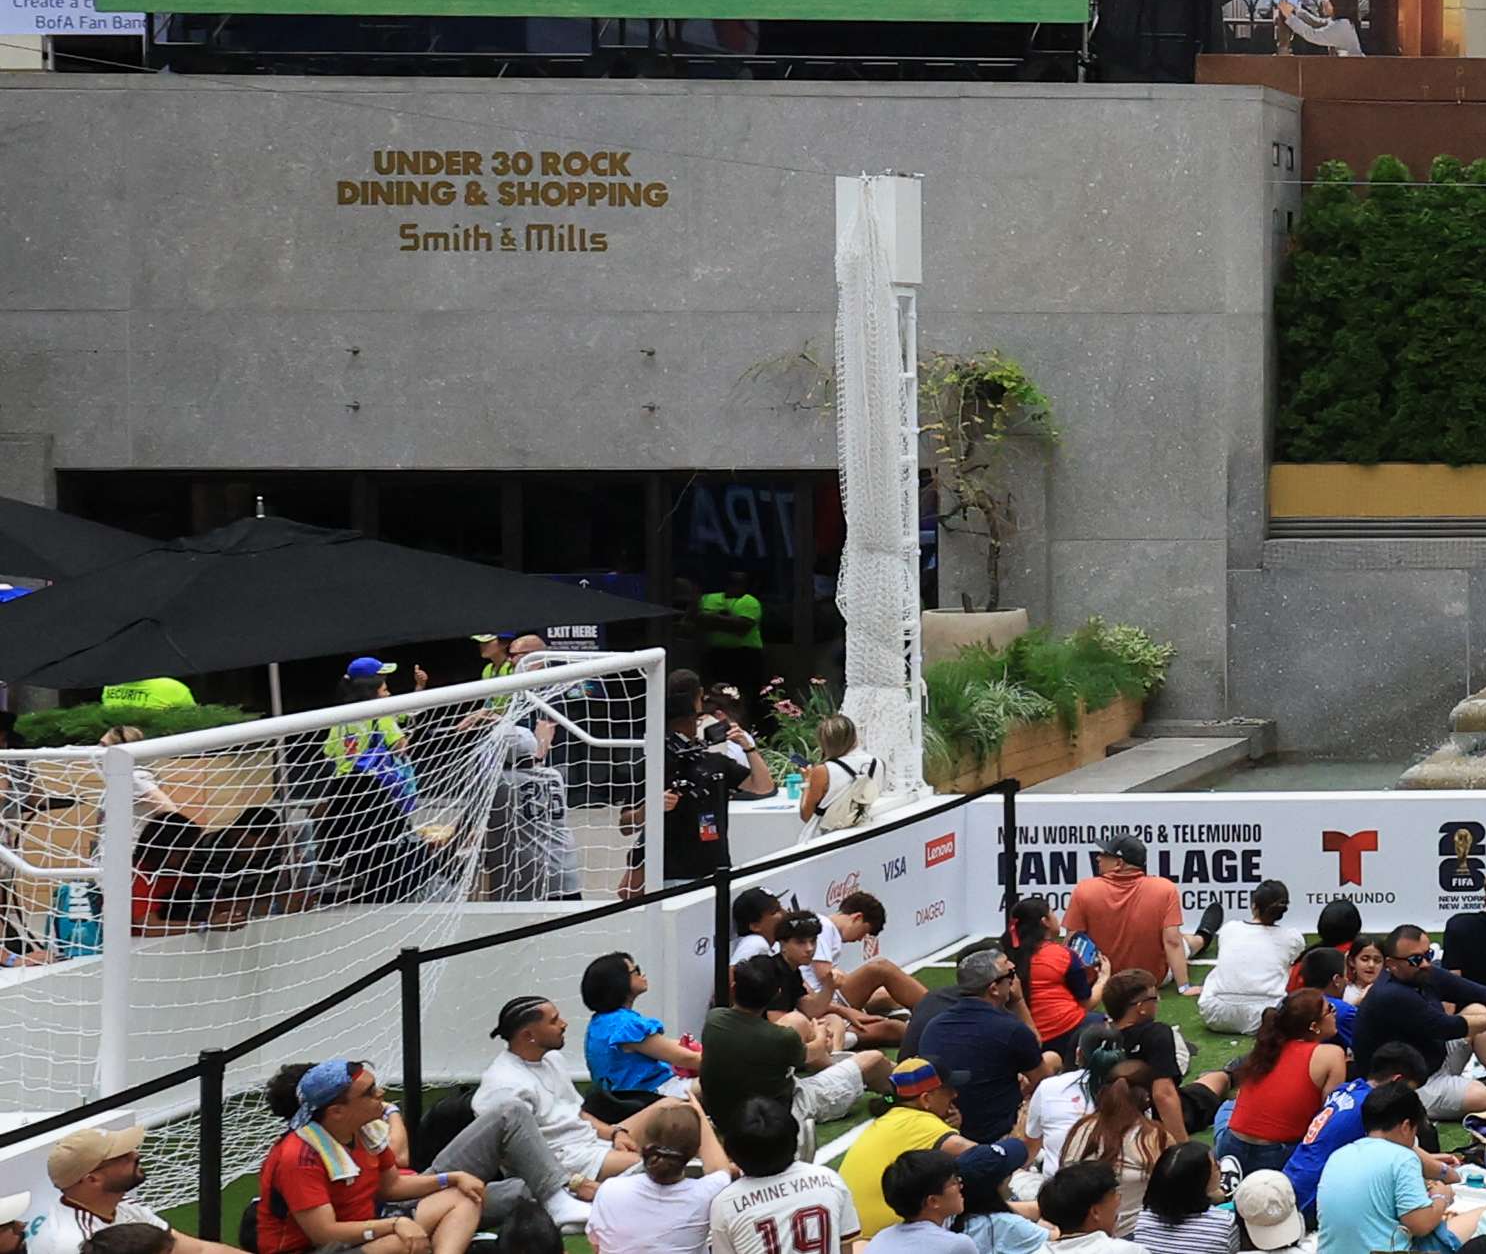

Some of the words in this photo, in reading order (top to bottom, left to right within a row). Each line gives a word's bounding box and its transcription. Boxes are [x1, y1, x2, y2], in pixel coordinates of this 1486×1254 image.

[35, 14, 75, 29] BofA
[79, 15, 107, 29] Fan
[374, 150, 483, 176] UNDER
[491, 150, 534, 177] 30
[541, 151, 632, 177] ROCK
[337, 180, 457, 206] DINING
[464, 181, 489, 207] &
[498, 181, 669, 207] SHOPPING
[399, 222, 493, 252] Smith
[500, 226, 517, 252] &
[525, 222, 609, 252] Mills
[547, 627, 570, 639] EXIT
[571, 625, 598, 638] HERE
[998, 825, 1039, 845] NNJ
[1043, 825, 1095, 845] WORLD
[1135, 824, 1153, 843] 26
[1158, 824, 1169, 843] &
[1173, 823, 1262, 844] TELEMUNDO
[926, 841, 954, 863] Lenovo
[882, 856, 907, 883] VISA
[1452, 877, 1474, 887] FIFA
[1182, 890, 1254, 911] CENTE
[1438, 895, 1460, 903] NEW
[1438, 903, 1460, 911] NEW
[915, 899, 946, 927] DIAGEO
[733, 1183, 788, 1213] LAMINE
[790, 1173, 835, 1197] YAMAL
[754, 1204, 831, 1254] 19
